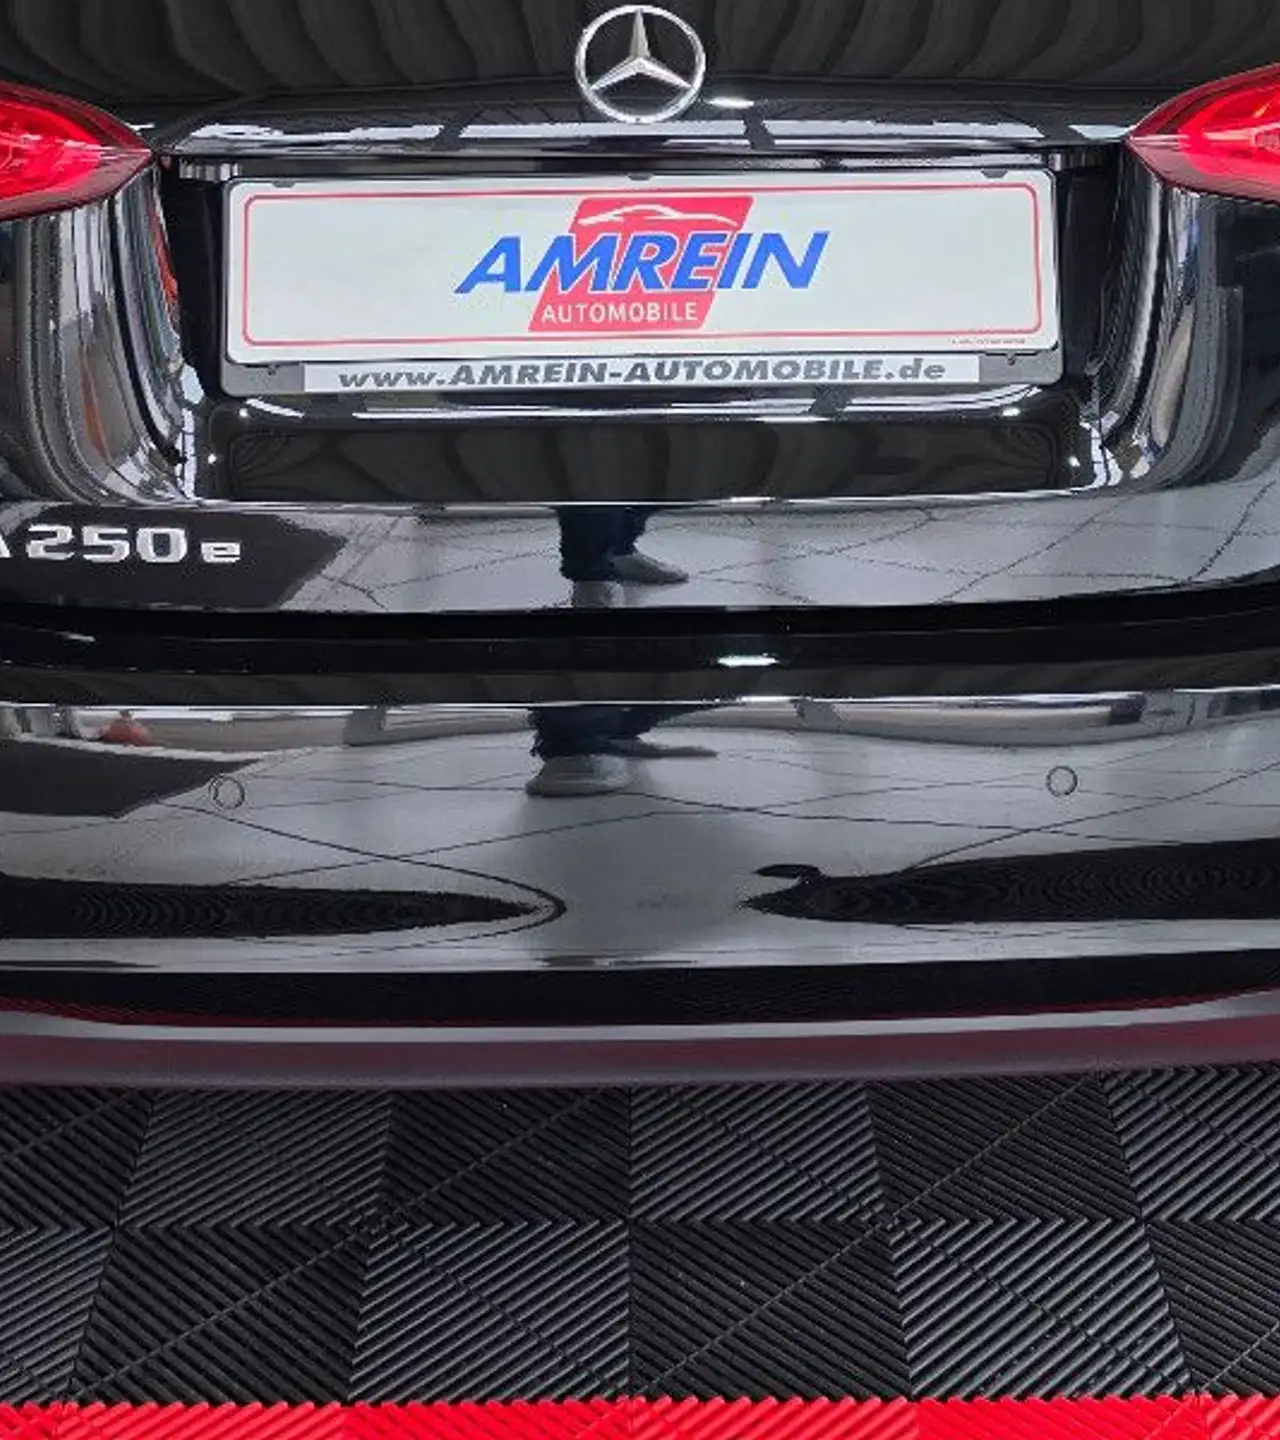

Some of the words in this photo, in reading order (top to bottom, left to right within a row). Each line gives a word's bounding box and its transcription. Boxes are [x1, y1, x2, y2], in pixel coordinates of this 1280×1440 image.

[453, 229, 833, 295] AMREIN
[540, 299, 699, 324] AUTOMOBILE
[337, 357, 947, 388] www.AMREIN-AUTOMOBILE.de
[24, 522, 189, 564] 250
